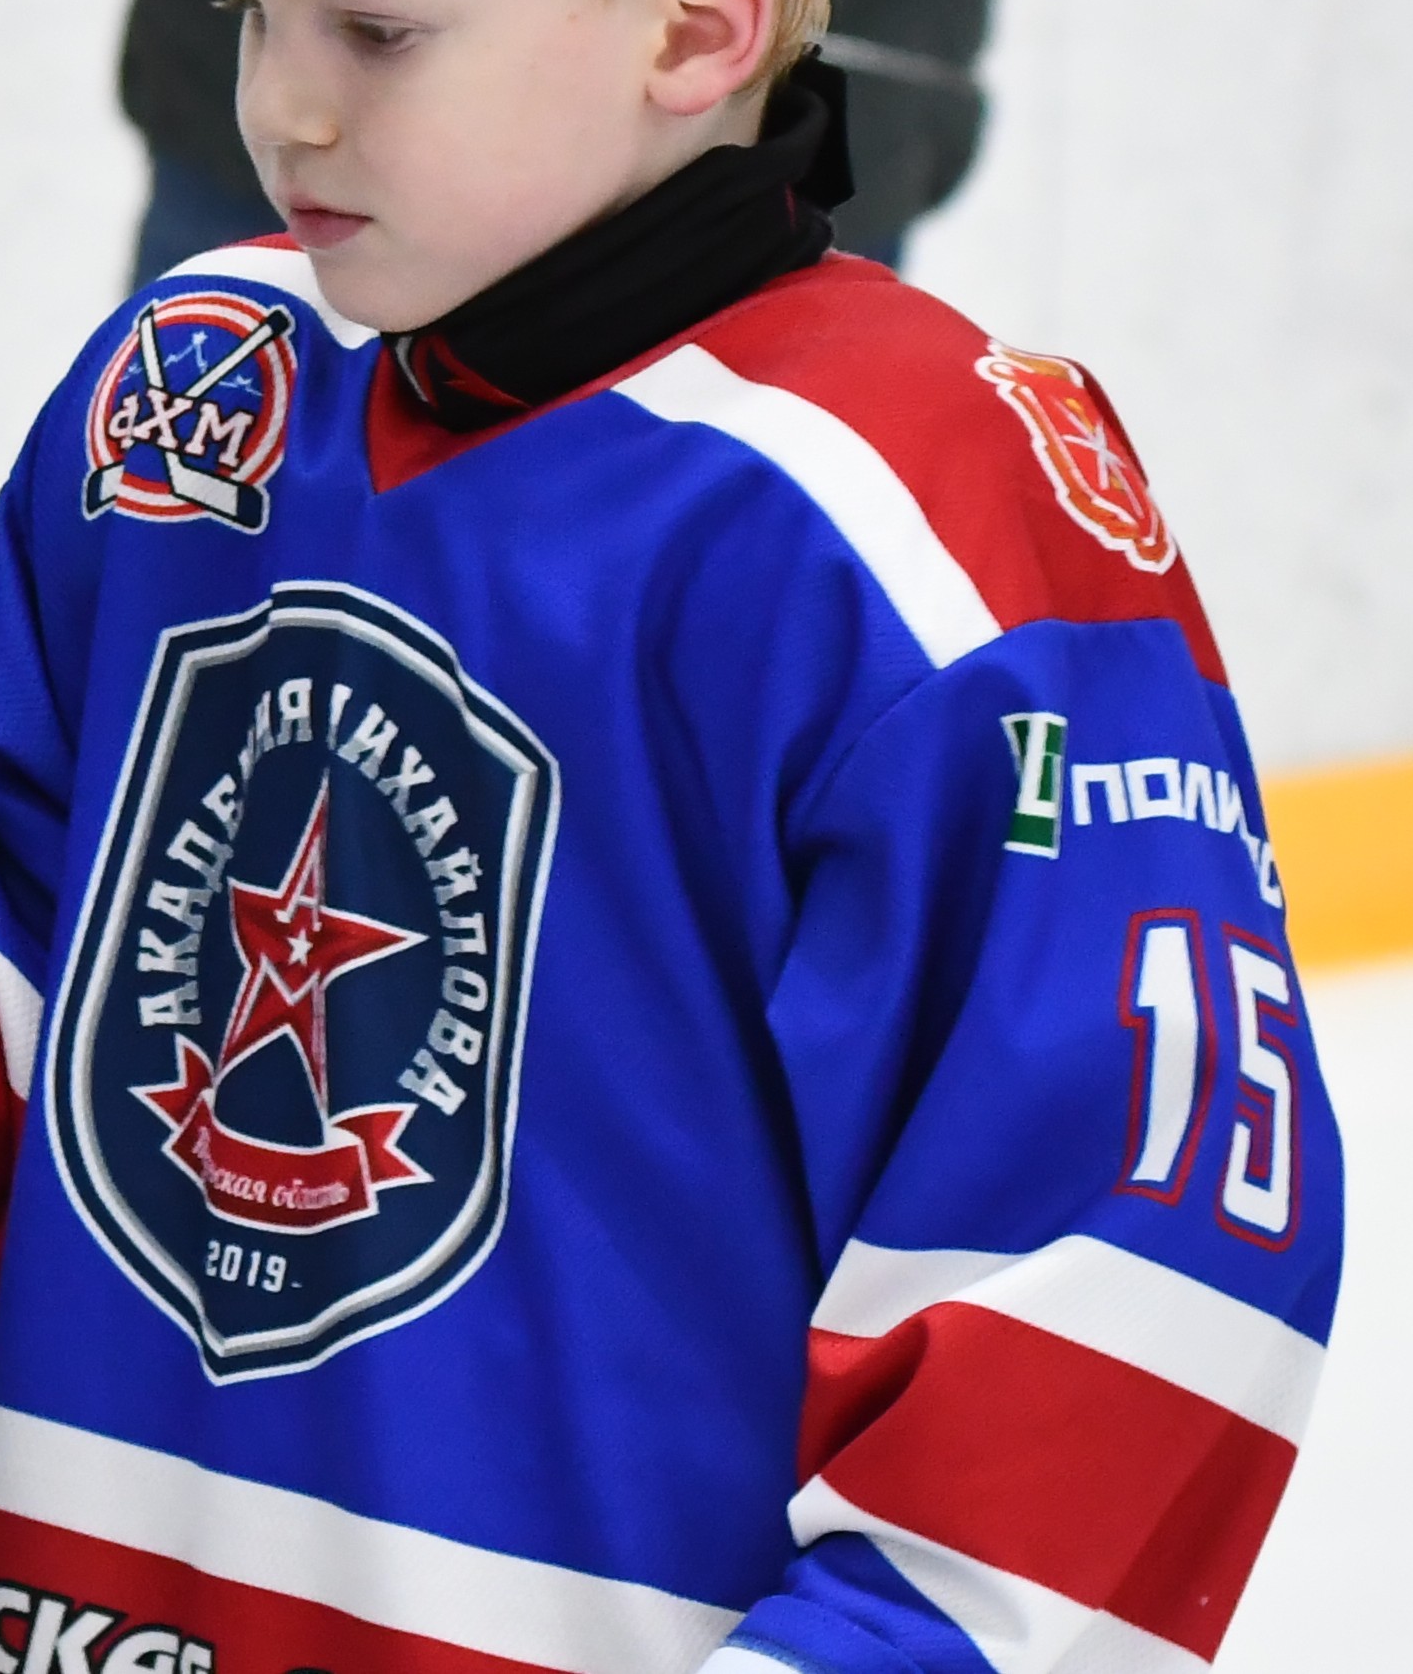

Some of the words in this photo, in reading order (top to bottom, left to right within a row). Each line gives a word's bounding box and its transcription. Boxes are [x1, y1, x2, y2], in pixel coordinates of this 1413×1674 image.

[135, 677, 314, 1027] АКАДЕИЯ
[1116, 908, 1298, 1252] 15
[205, 1239, 287, 1293] 2019
